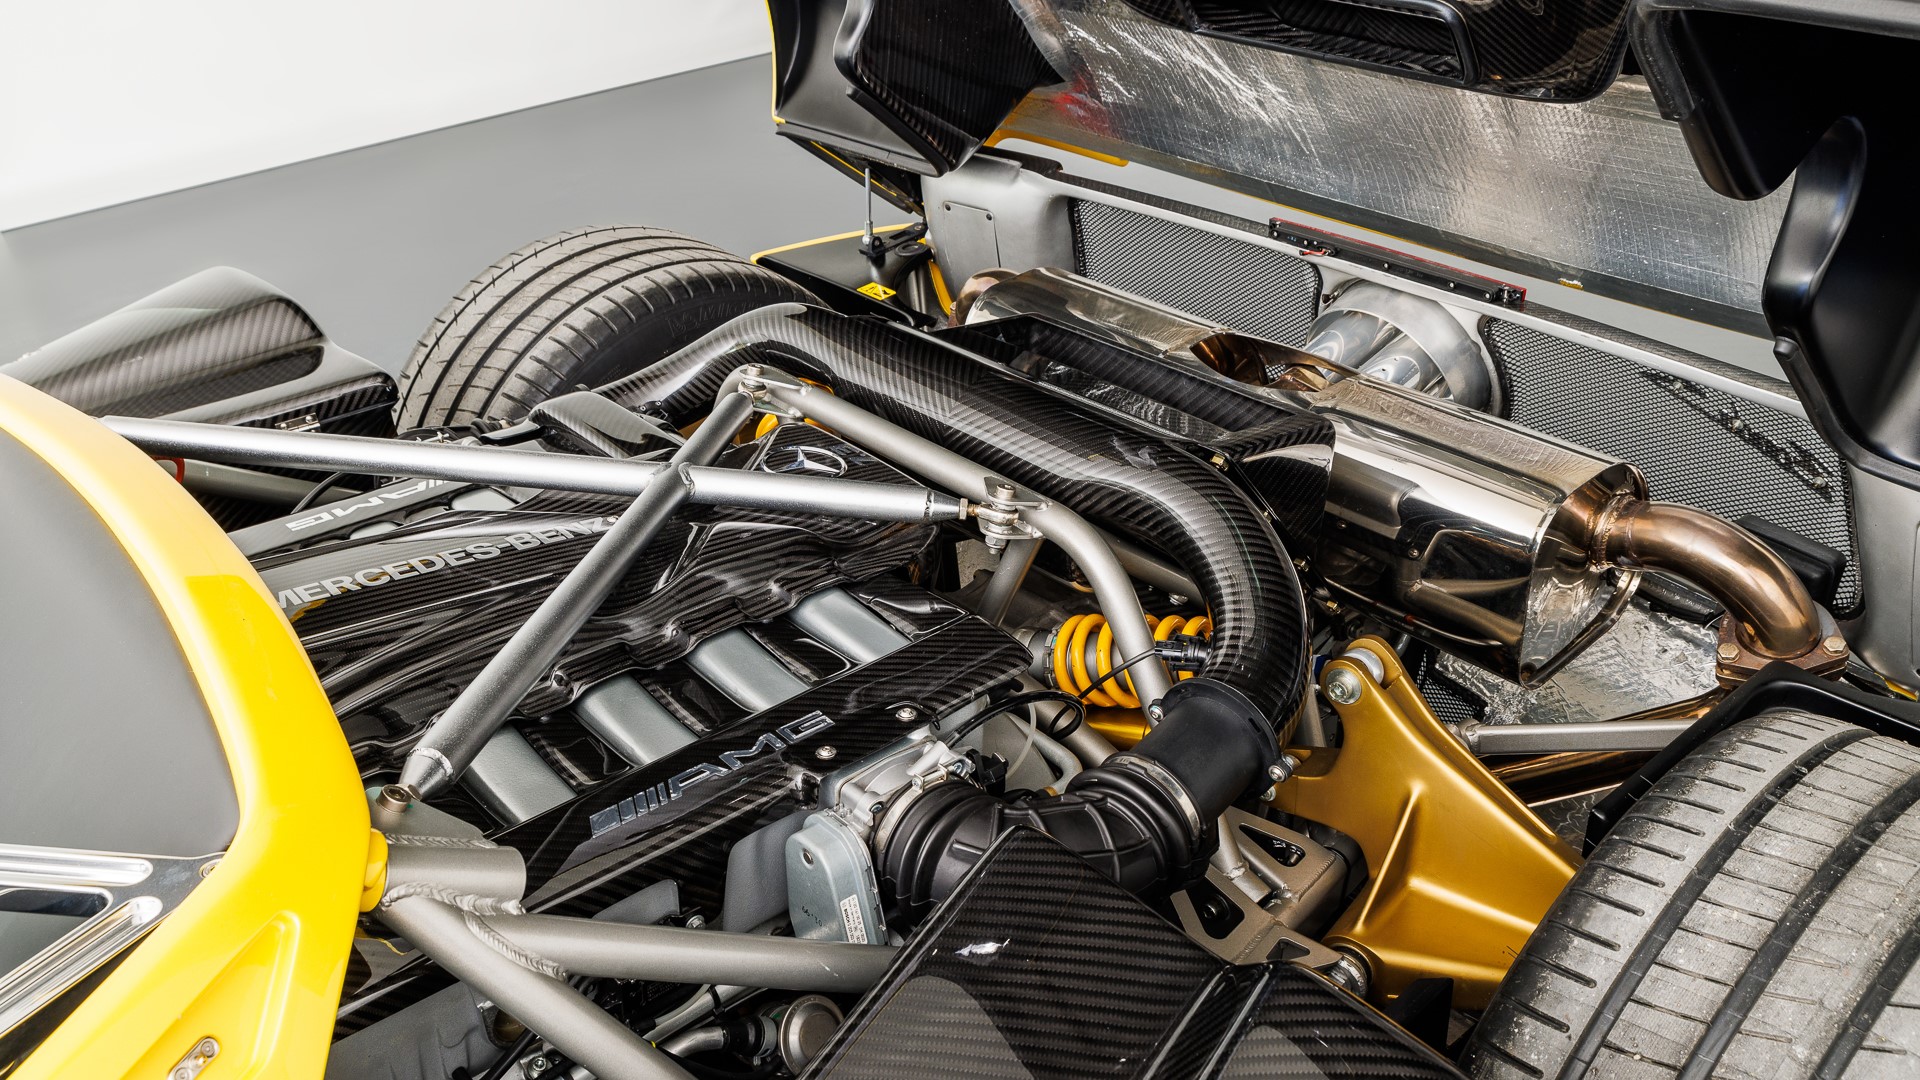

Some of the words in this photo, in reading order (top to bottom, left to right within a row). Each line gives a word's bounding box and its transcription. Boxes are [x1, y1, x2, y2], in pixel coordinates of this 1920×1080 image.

[285, 480, 428, 532] AMG
[277, 516, 613, 609] MERCEDES-BENZ
[668, 709, 836, 801] AMG
